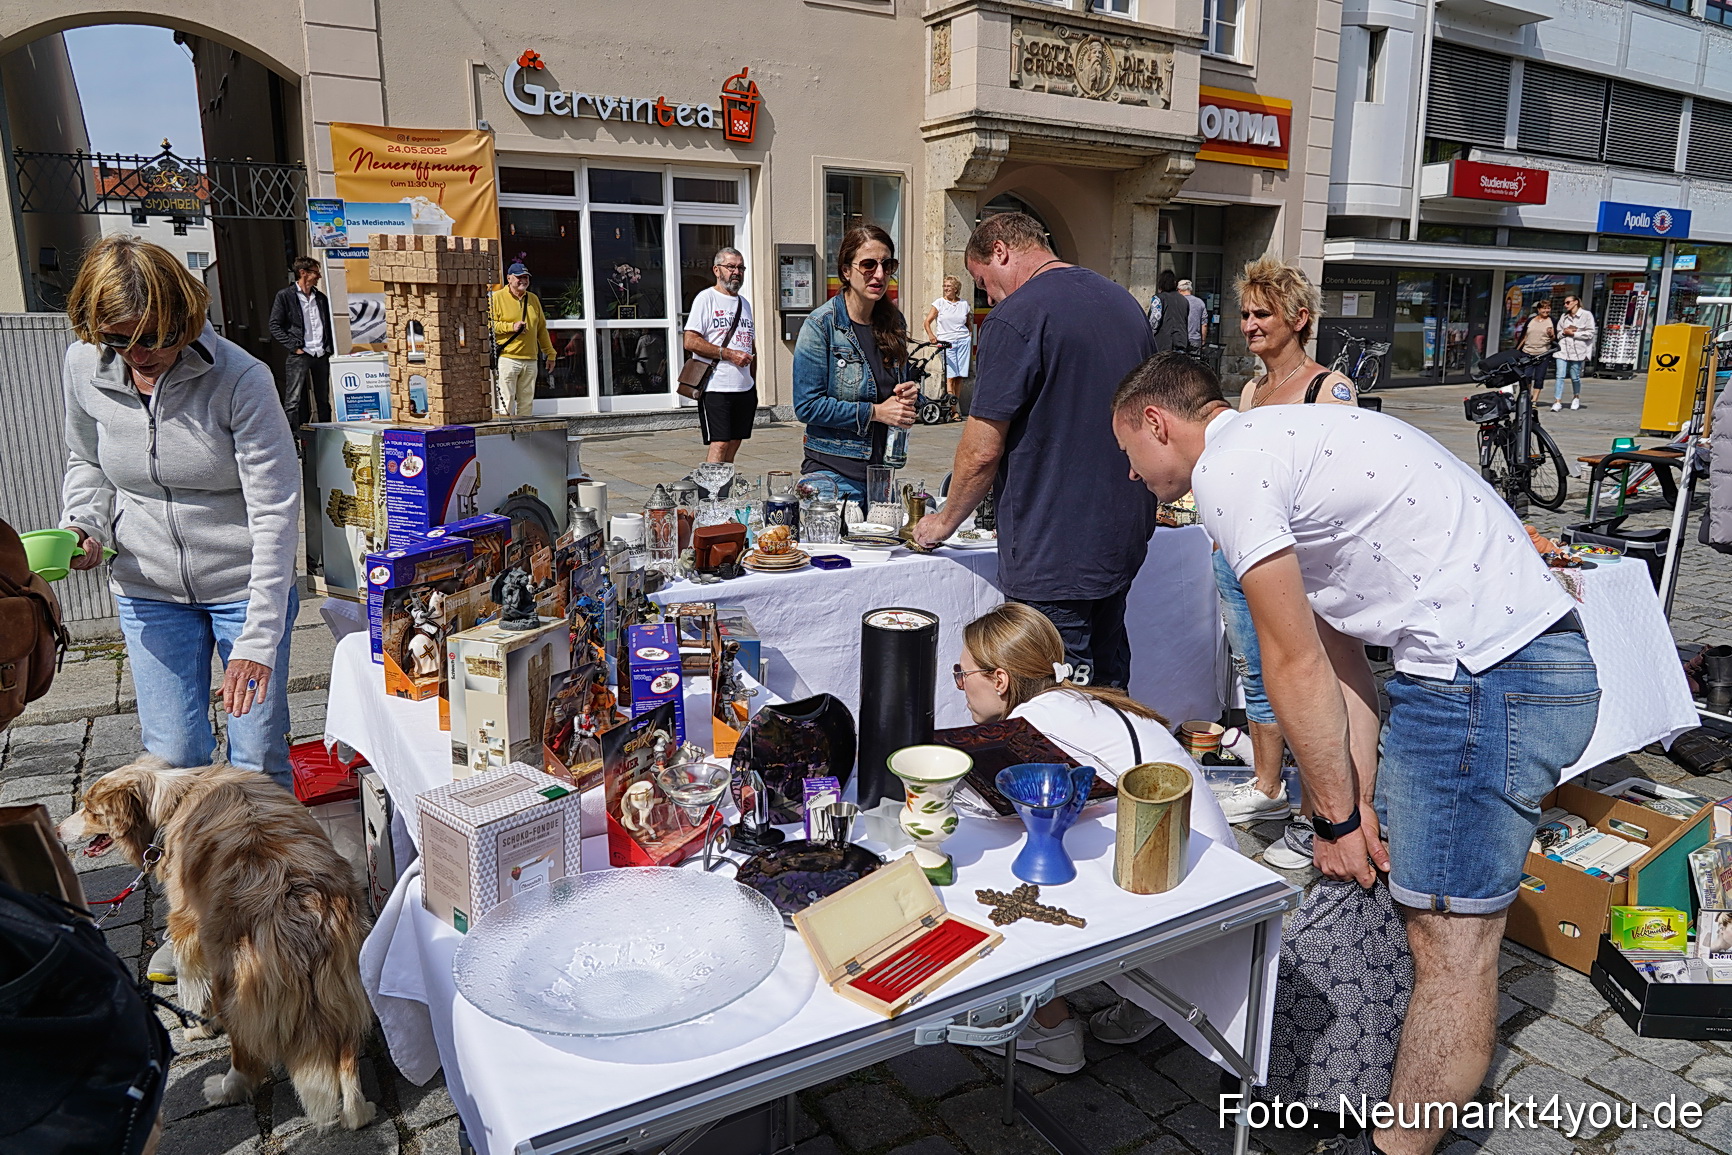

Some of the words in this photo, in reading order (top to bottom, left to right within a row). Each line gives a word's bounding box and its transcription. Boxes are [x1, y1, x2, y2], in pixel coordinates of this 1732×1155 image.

[503, 59, 713, 128] Gervintea
[1200, 104, 1281, 148] ORMA
[387, 145, 448, 155] 24.05.2022
[348, 147, 483, 184] Neueröffnung
[428, 180, 446, 189] Uhr)
[1480, 175, 1518, 190] Studienkreis
[1624, 211, 1650, 230] Apollo
[1348, 277, 1385, 285] Marktstrasse
[502, 818, 559, 848] SCHOKO-FONDUE
